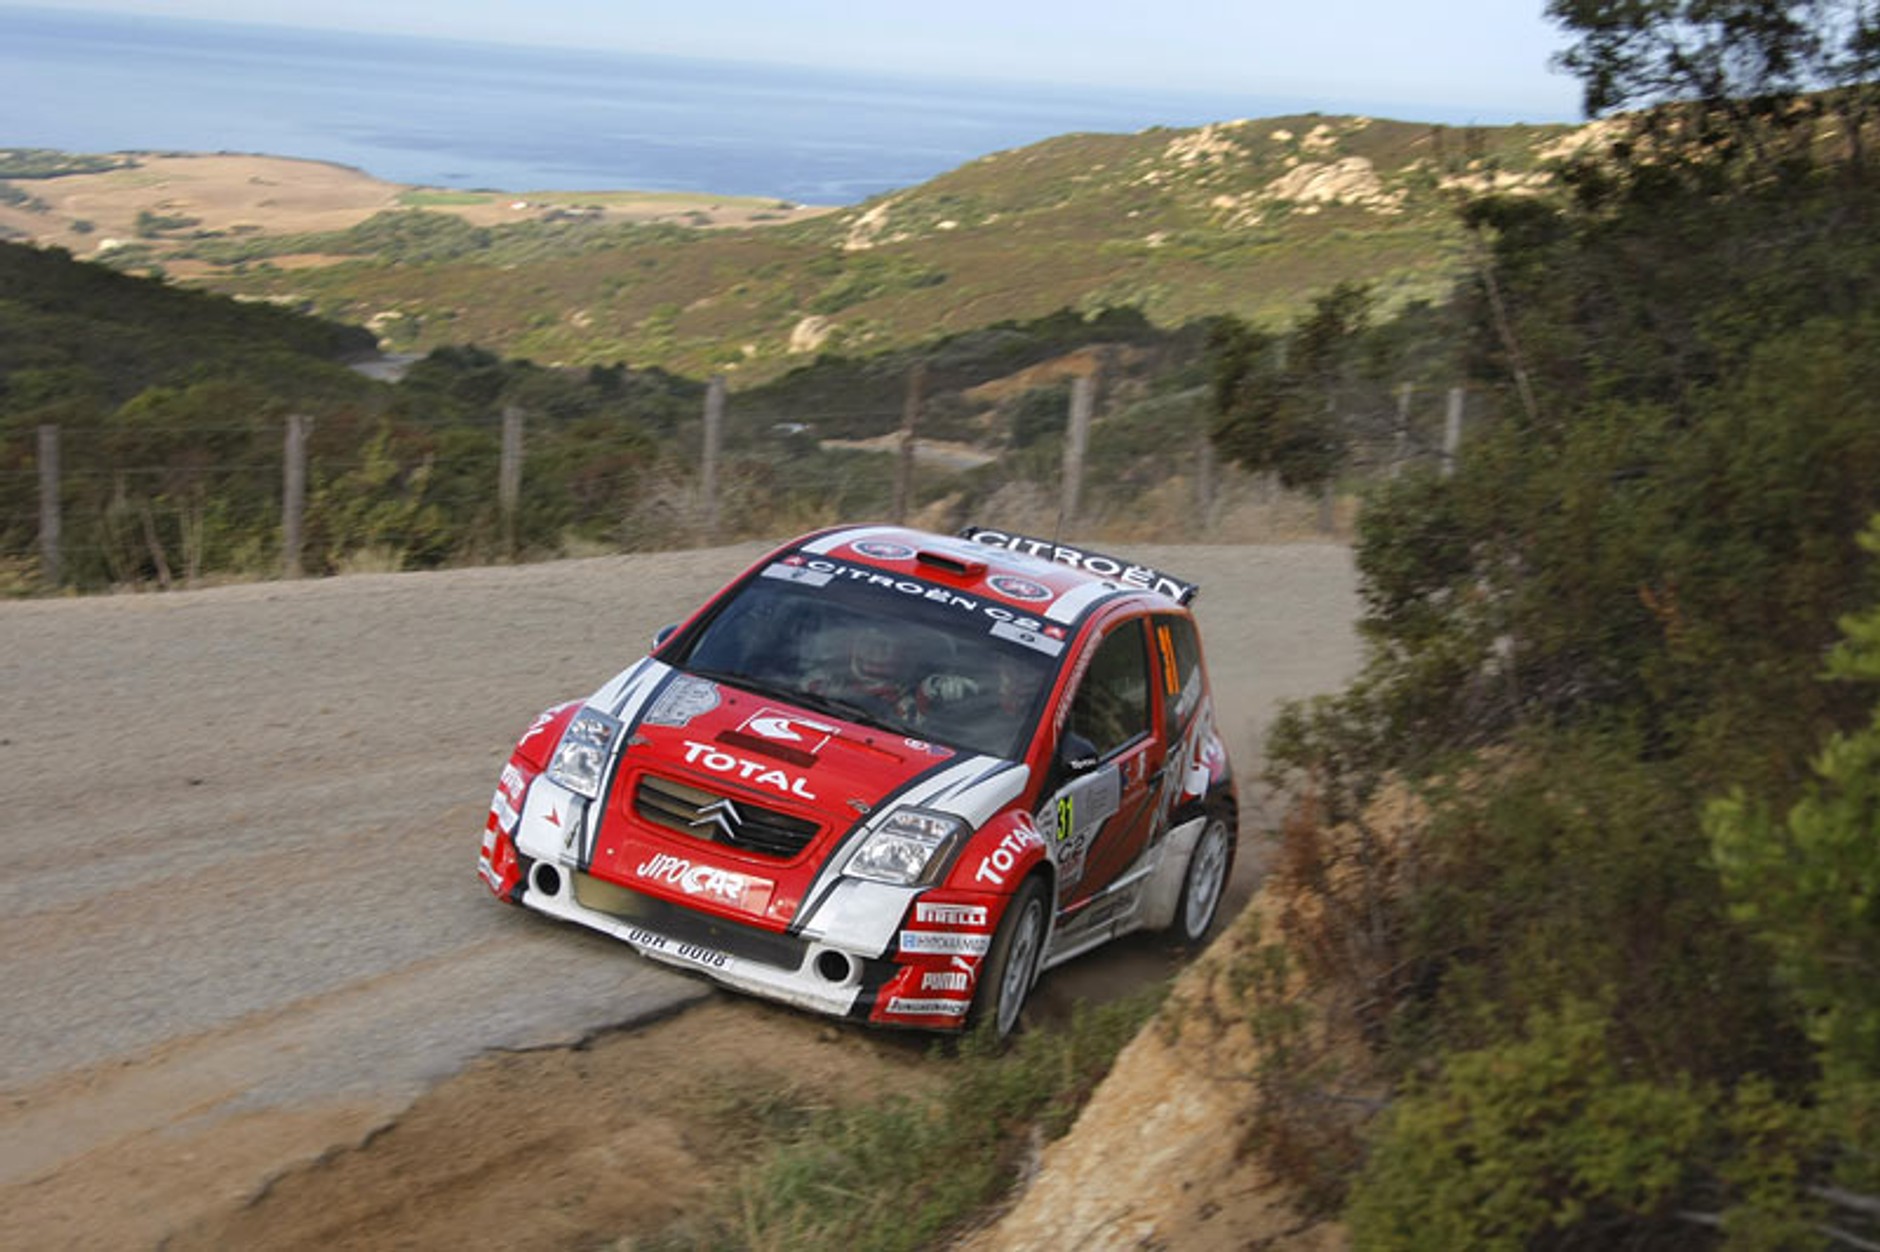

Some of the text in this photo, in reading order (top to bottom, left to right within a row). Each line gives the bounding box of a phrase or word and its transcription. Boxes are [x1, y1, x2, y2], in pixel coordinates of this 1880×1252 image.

[807, 560, 977, 611] CITROËN
[984, 607, 1041, 632] C2
[970, 531, 1188, 602] CITROËN
[683, 740, 816, 800] TOTAL
[976, 815, 1045, 884] TOTAL
[1057, 794, 1074, 840] 31
